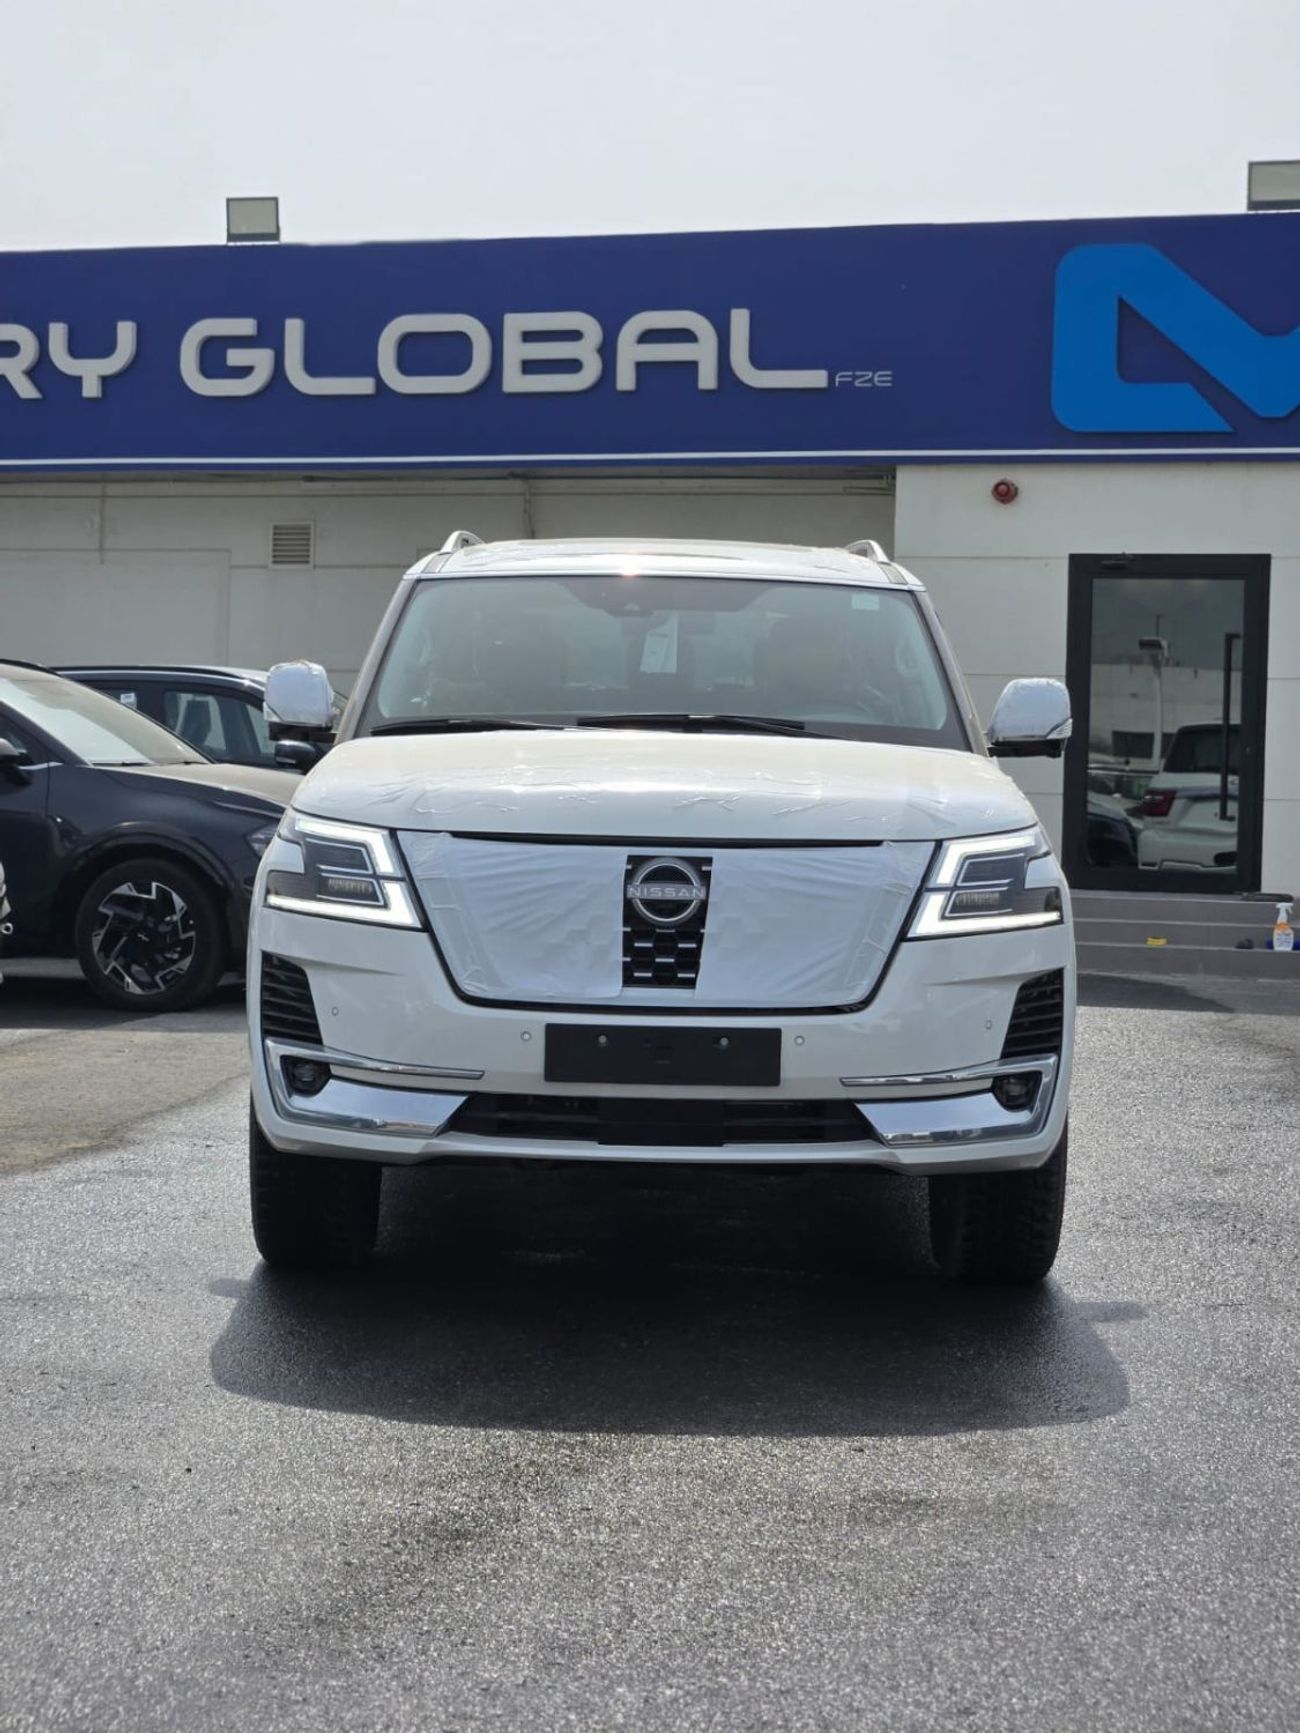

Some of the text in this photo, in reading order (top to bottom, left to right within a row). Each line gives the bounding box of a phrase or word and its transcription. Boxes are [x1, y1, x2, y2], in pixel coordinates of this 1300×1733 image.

[180, 308, 829, 397] GLOBAL
[835, 370, 893, 388] FZE
[629, 886, 704, 898] NISSAN
